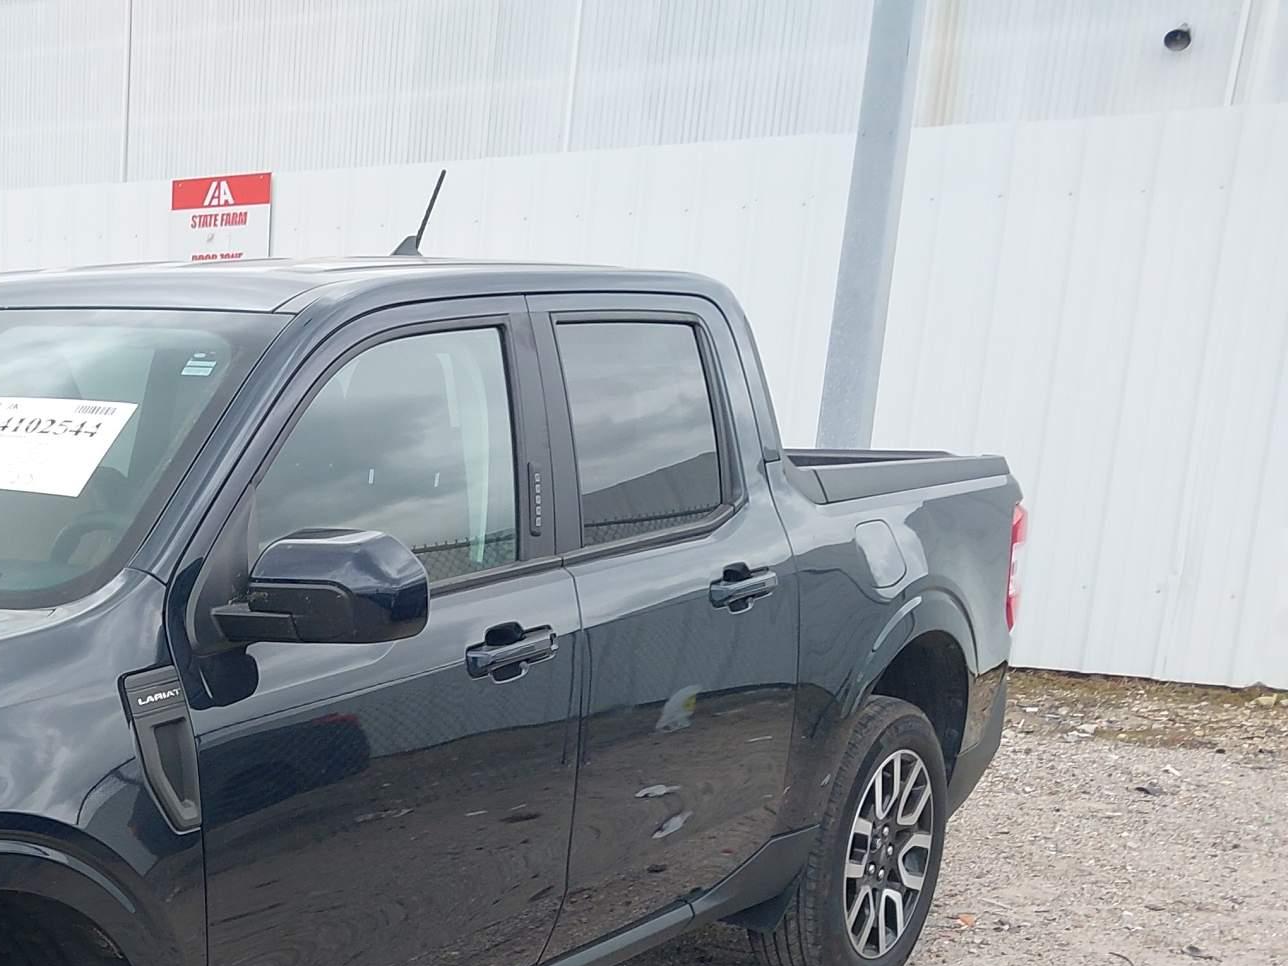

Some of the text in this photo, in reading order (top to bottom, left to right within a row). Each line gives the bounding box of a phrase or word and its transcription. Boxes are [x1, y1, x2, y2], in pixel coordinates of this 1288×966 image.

[191, 211, 248, 229] STATE FARM
[137, 688, 181, 705] LARIAT
